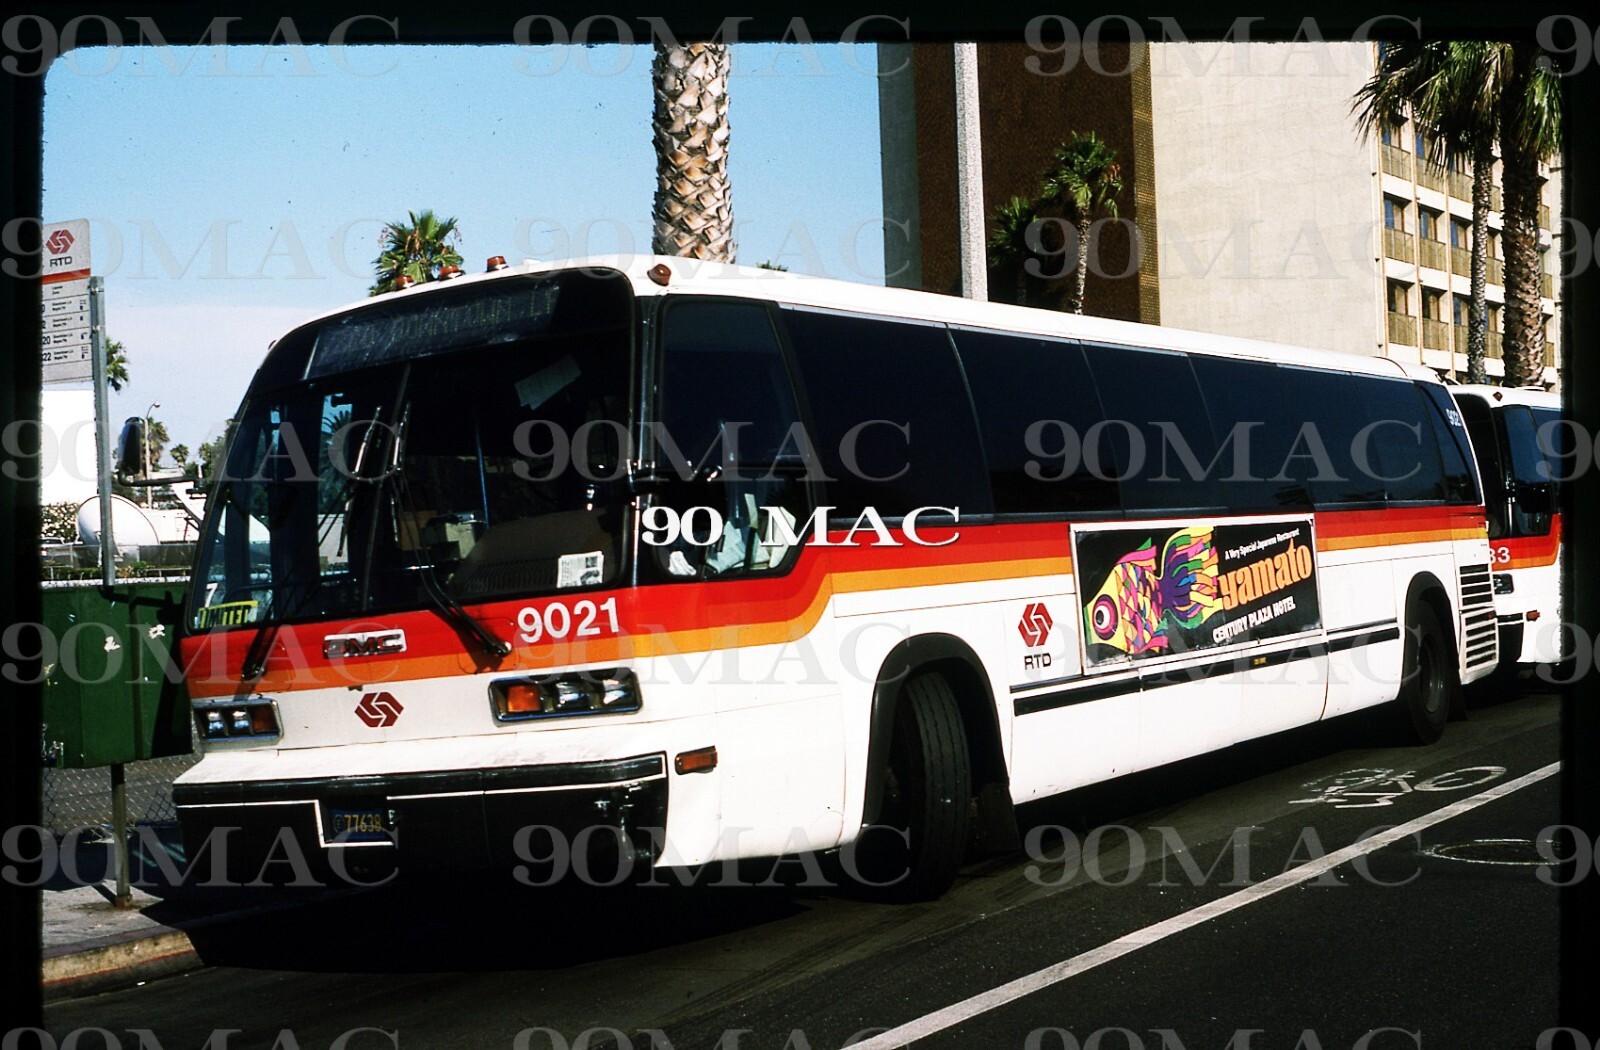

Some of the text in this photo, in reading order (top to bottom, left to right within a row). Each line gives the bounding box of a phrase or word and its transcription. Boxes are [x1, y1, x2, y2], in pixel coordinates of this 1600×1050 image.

[50, 256, 73, 267] RTD
[1224, 550, 1230, 561] A
[1239, 541, 1257, 556] Special
[1217, 538, 1314, 611] yamato
[206, 582, 218, 608] 7
[517, 597, 620, 643] 9021
[1212, 595, 1297, 644] CENTURY PLAZA HOTEL
[323, 634, 404, 658] GMC
[1024, 652, 1052, 670] RTD
